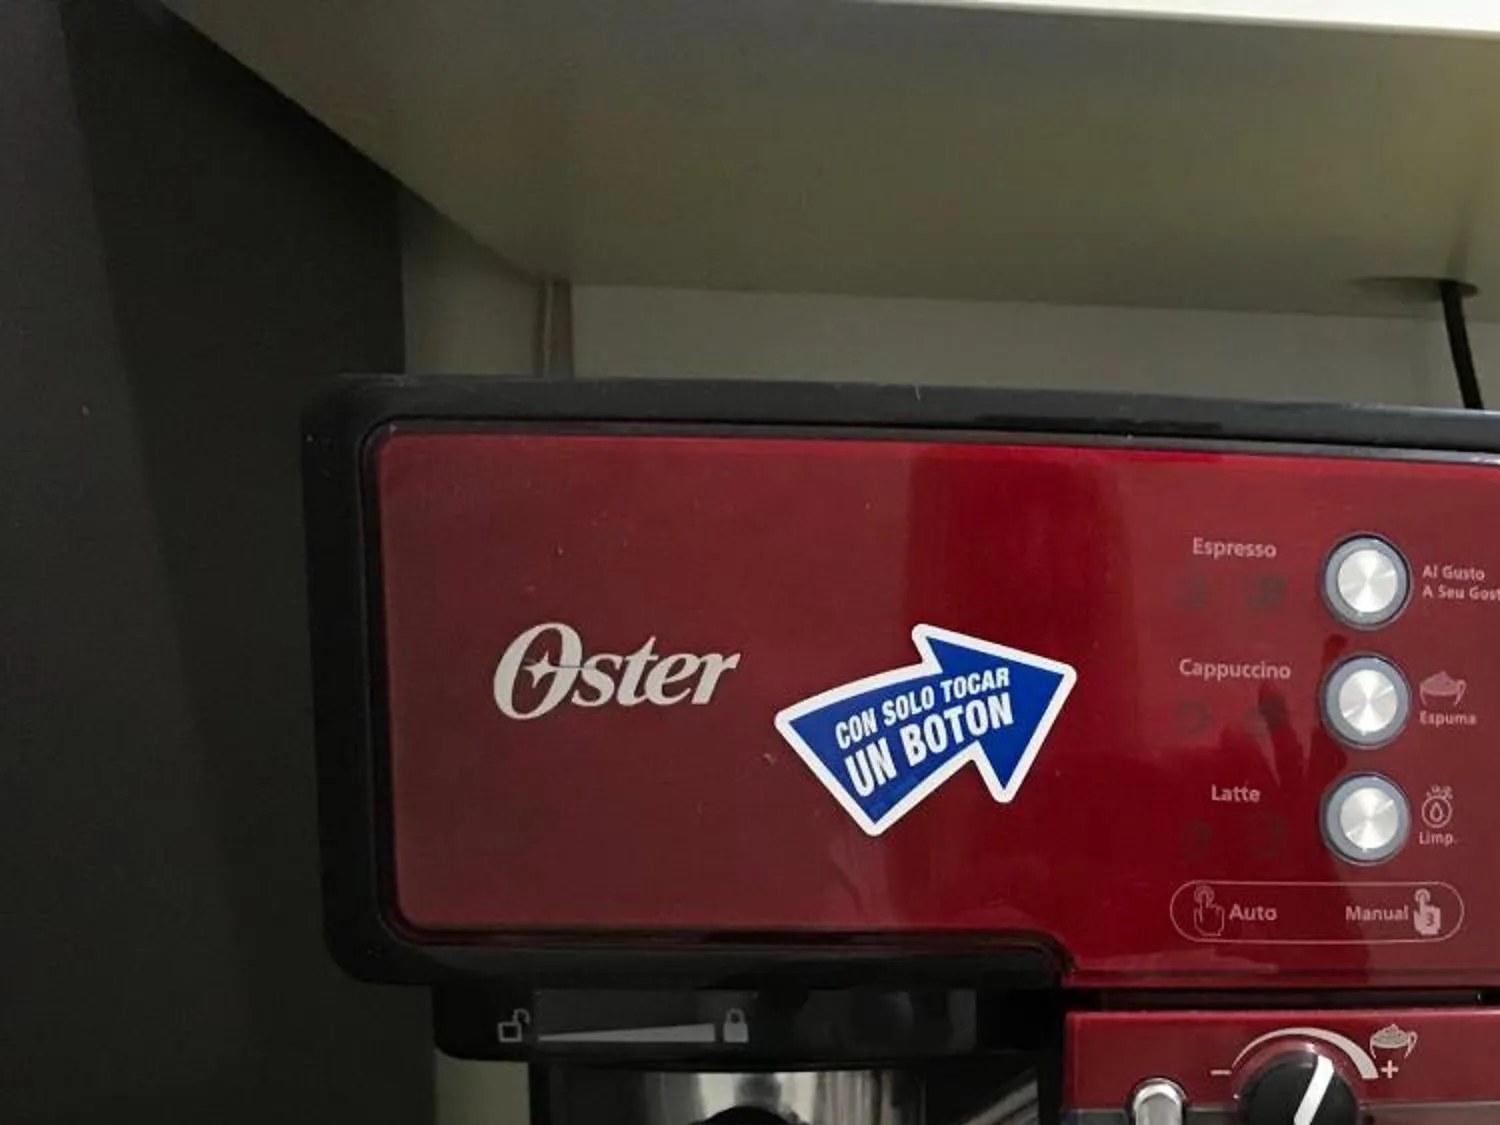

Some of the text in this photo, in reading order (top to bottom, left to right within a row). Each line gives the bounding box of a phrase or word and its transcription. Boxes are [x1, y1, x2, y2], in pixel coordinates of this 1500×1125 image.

[1192, 537, 1277, 559] Espresso
[1422, 565, 1486, 581] Al Gusto
[1422, 586, 1433, 598] A
[1437, 586, 1464, 600] Seu
[493, 621, 742, 720] Oster
[1178, 658, 1292, 681] Cappuccino
[835, 667, 1010, 749] CON SOLO TOCAR
[1419, 711, 1477, 727] Espuma
[844, 692, 1015, 797] UN BOTON
[1211, 784, 1261, 803] Latte
[1419, 830, 1457, 846] Limp.
[1228, 904, 1278, 922] Auto
[1345, 904, 1410, 922] Manual
